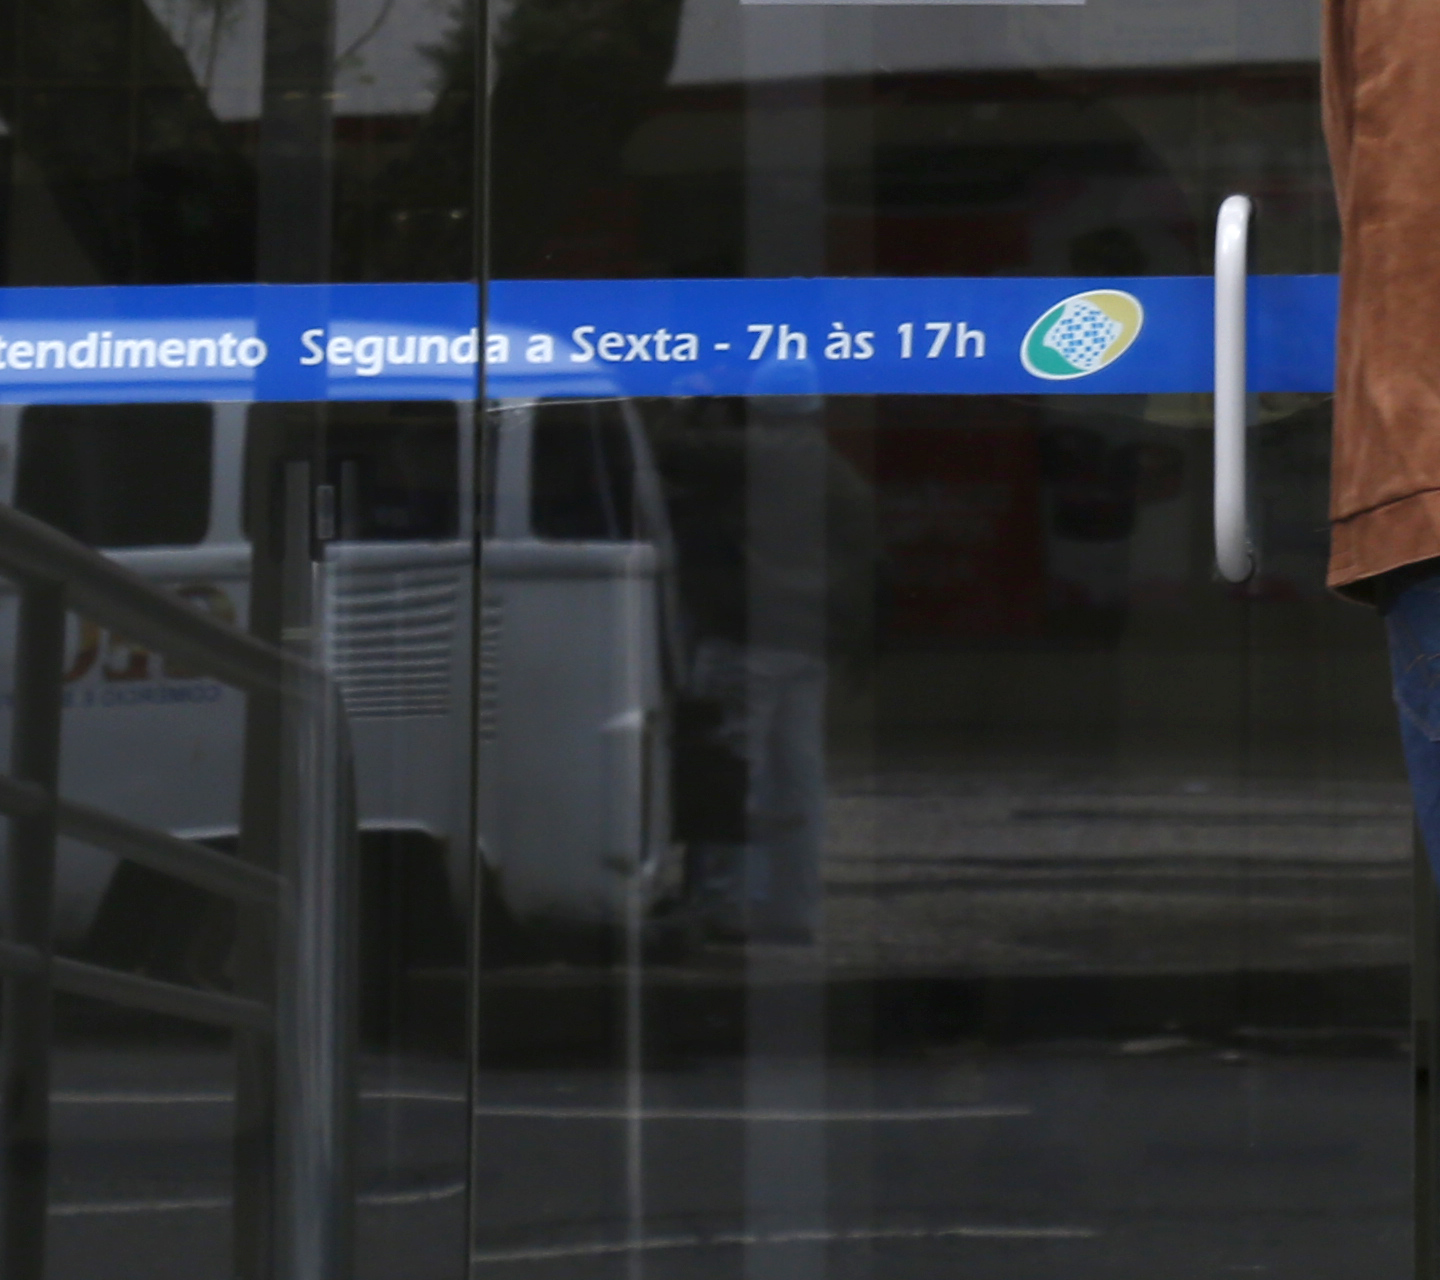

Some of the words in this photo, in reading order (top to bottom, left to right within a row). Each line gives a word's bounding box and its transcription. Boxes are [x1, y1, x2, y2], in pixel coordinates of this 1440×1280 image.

[300, 327, 510, 377] Segunda
[524, 335, 555, 365] a
[570, 325, 700, 363] Sexta
[747, 323, 808, 362] 7h
[824, 321, 876, 361] às
[897, 321, 988, 360] 17h
